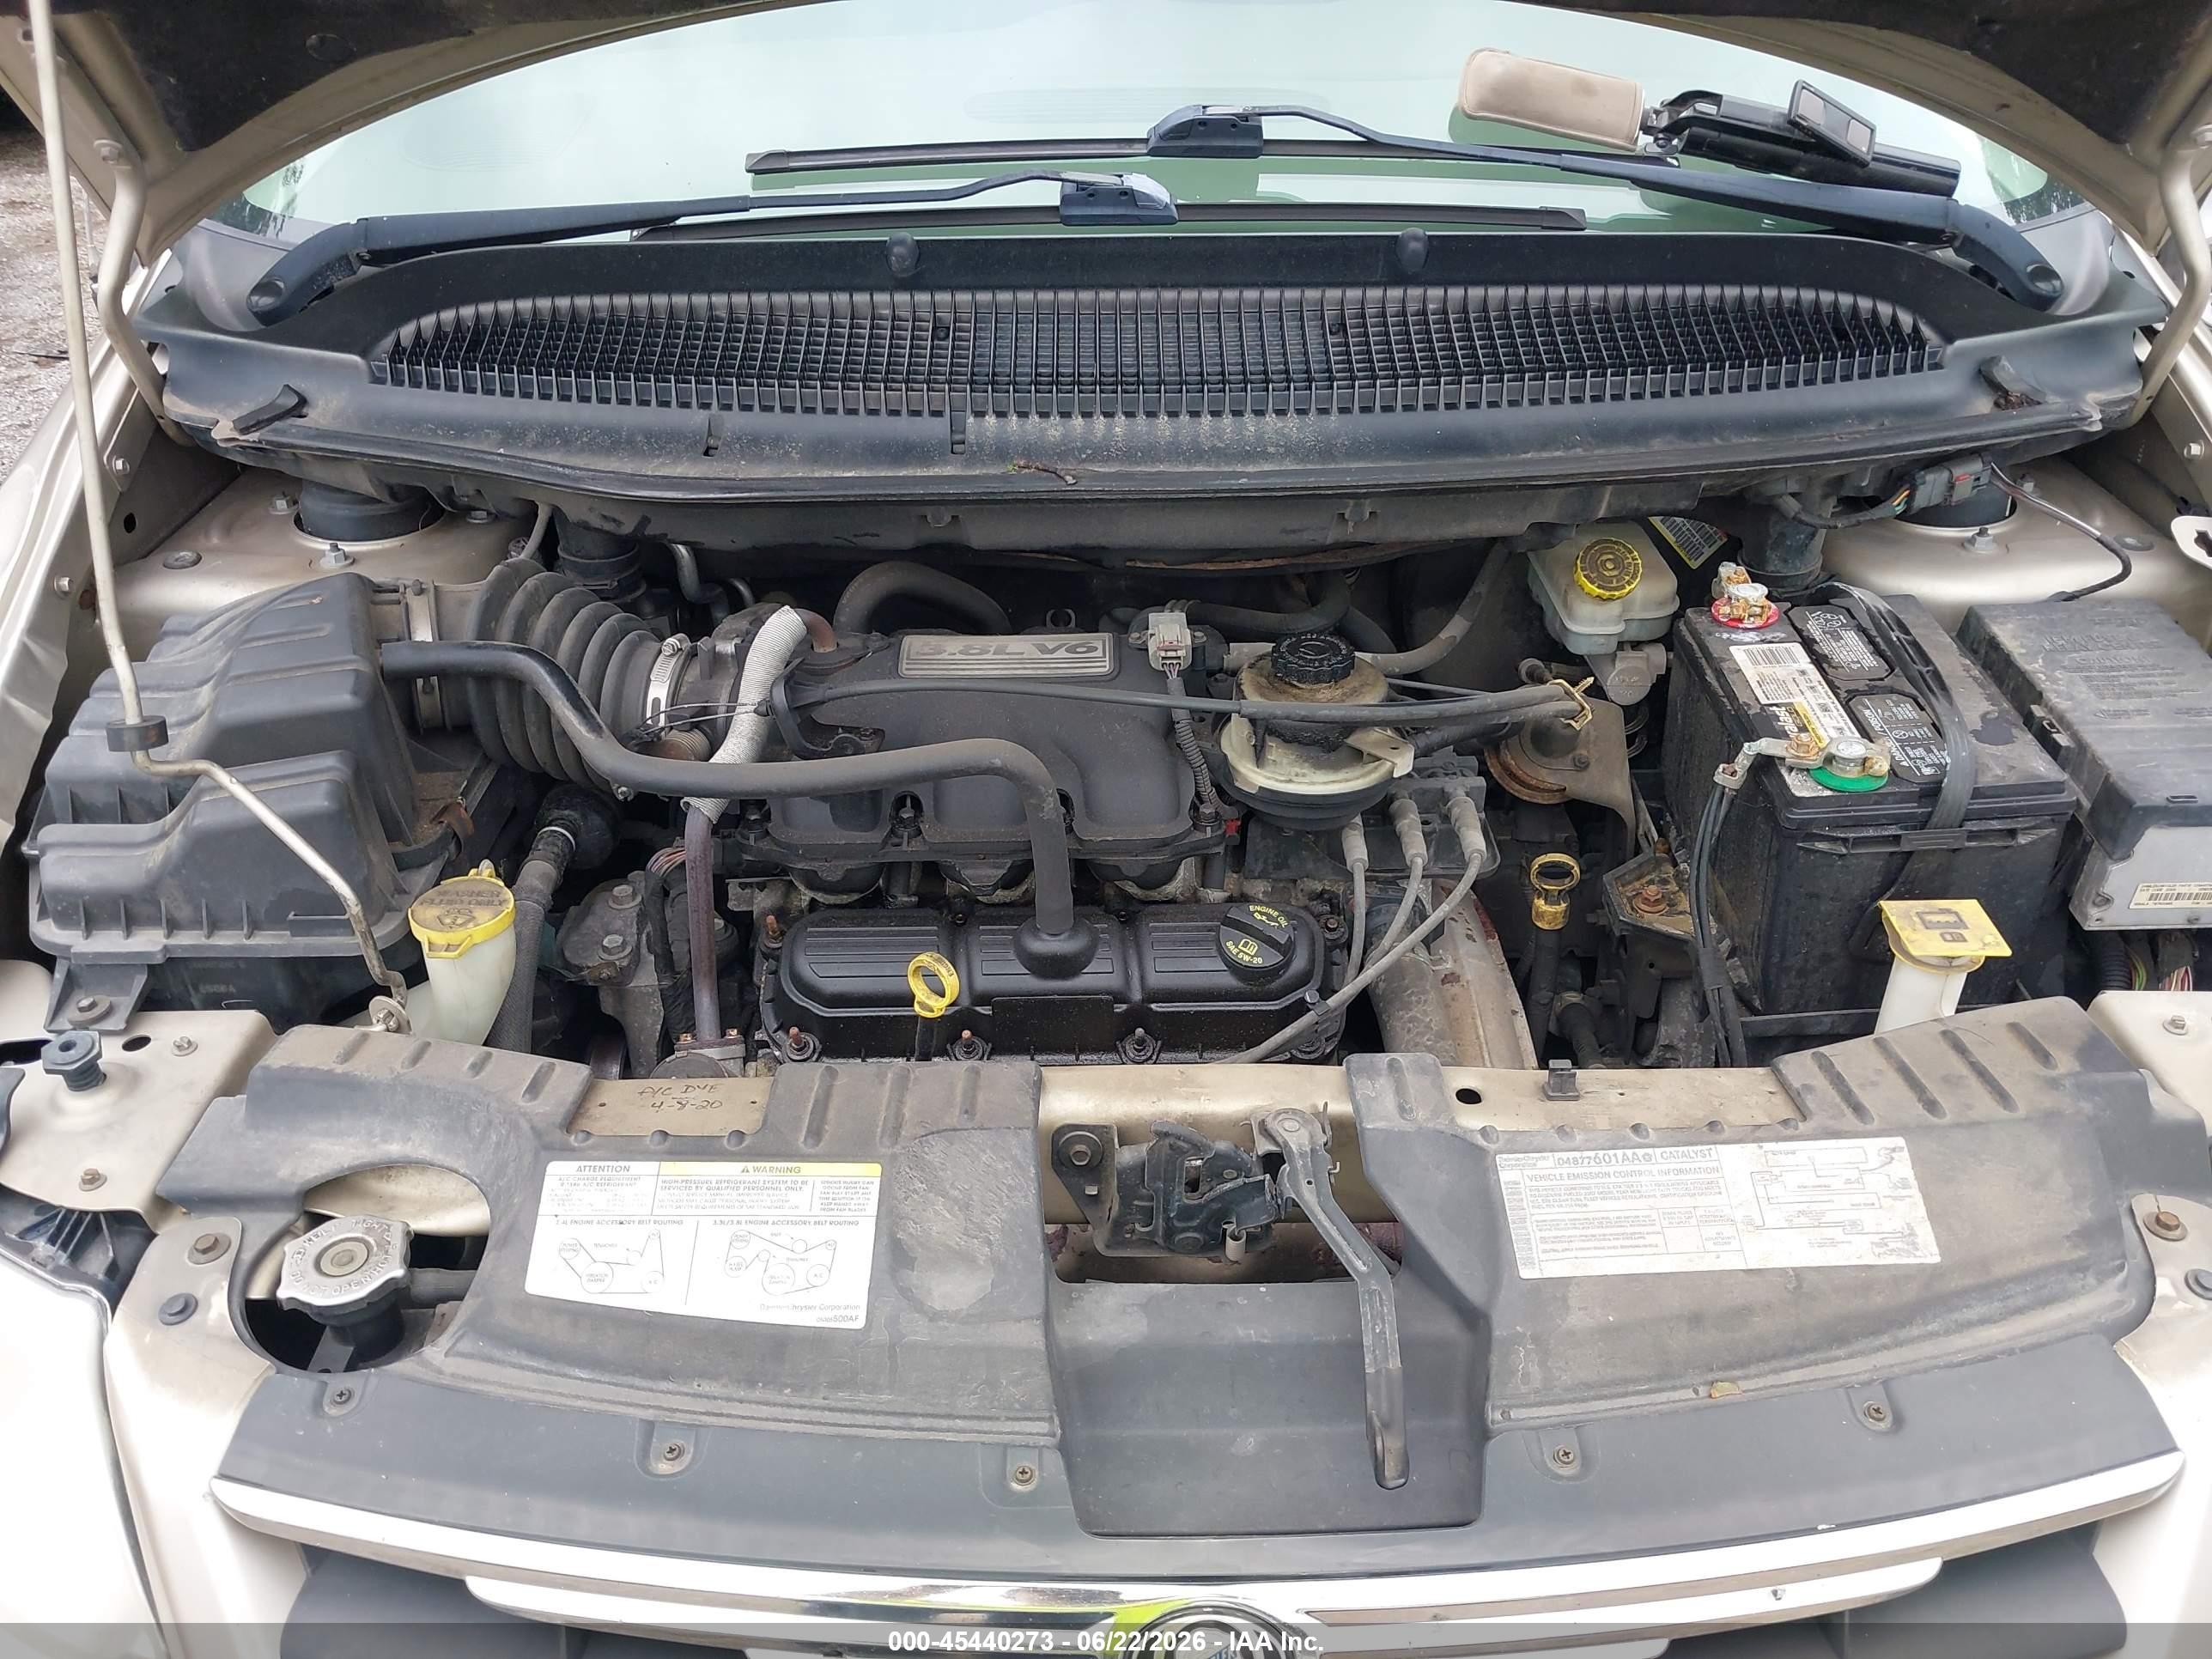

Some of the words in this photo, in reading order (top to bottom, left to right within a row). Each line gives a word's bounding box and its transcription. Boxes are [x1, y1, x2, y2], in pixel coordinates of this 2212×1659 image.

[915, 643, 1024, 656] 3.8L
[1031, 641, 1098, 655] V6
[1769, 706, 1799, 738] ralast
[1863, 709, 1885, 731] POISON
[468, 898, 509, 907] ONLY
[1249, 905, 1279, 918] ENGINE
[1277, 915, 1289, 928] OIL
[1225, 940, 1240, 956] SAE
[1237, 951, 1263, 964] 5W-20
[1660, 1147, 1713, 1160] CATALYST
[576, 1164, 631, 1173] ATTENTION
[751, 1165, 802, 1174] WARNING
[1527, 1170, 1566, 1182] VEHICLE
[1566, 1170, 1612, 1181] EMISSION
[1612, 1168, 1656, 1179] CONTROL
[1657, 1166, 1720, 1176] INFORMATION
[331, 1273, 373, 1296] OPEN
[818, 1304, 860, 1312] Corporation
